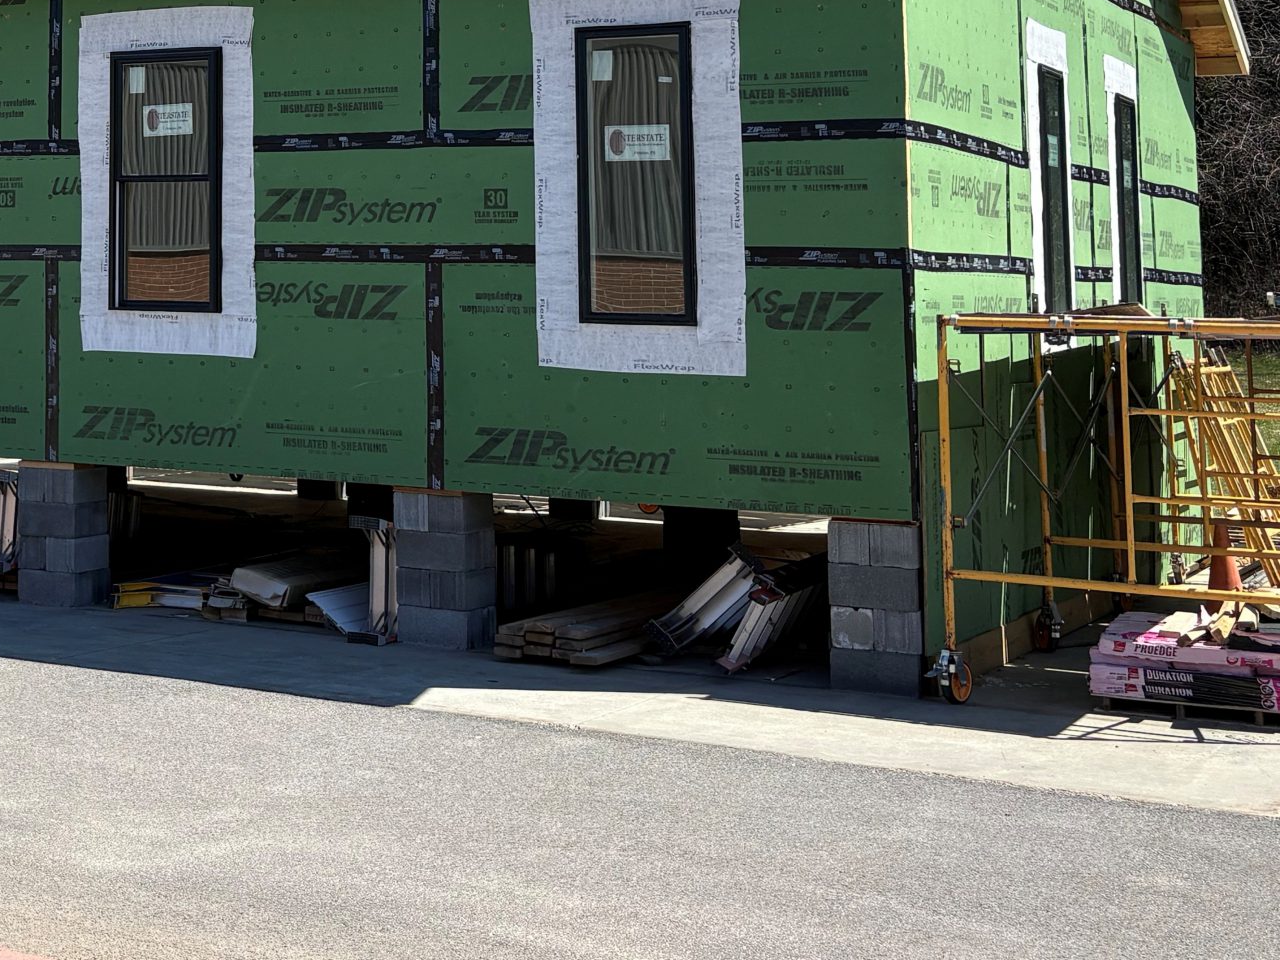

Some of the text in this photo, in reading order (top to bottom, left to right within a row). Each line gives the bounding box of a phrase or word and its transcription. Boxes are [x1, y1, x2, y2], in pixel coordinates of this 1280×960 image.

[741, 89, 774, 100] LATED
[743, 184, 770, 192] BARRIE
[0, 191, 15, 207] 30
[485, 190, 507, 208] 30
[733, 173, 741, 229] FlexWrap
[633, 363, 695, 372] FlexWrap
[729, 463, 786, 478] INSULATED
[1133, 643, 1178, 657] PROEDGE
[1146, 669, 1194, 683] DURATION
